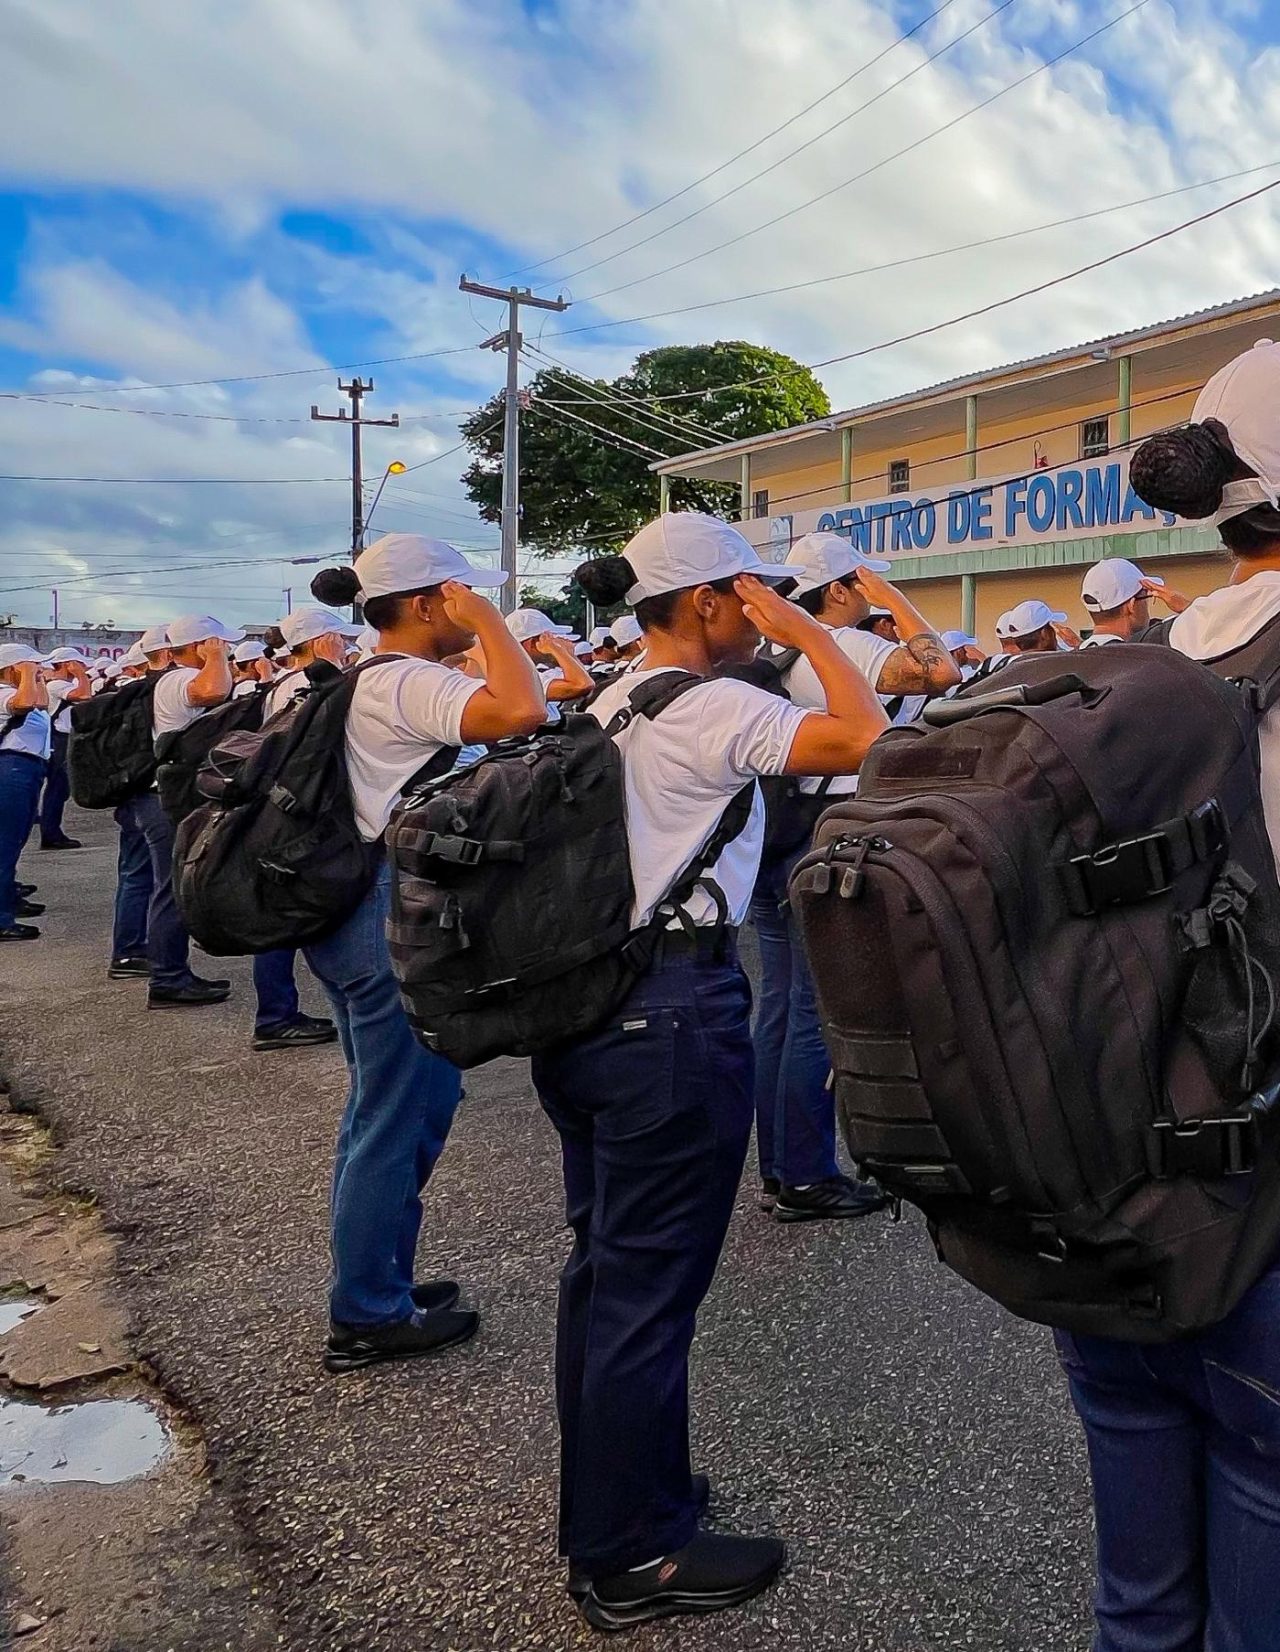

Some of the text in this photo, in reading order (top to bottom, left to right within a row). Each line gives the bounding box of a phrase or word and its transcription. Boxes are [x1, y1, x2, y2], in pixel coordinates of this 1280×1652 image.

[817, 497, 936, 553] CENTRO
[948, 485, 993, 544] DE
[1005, 463, 1176, 537] FORMA
